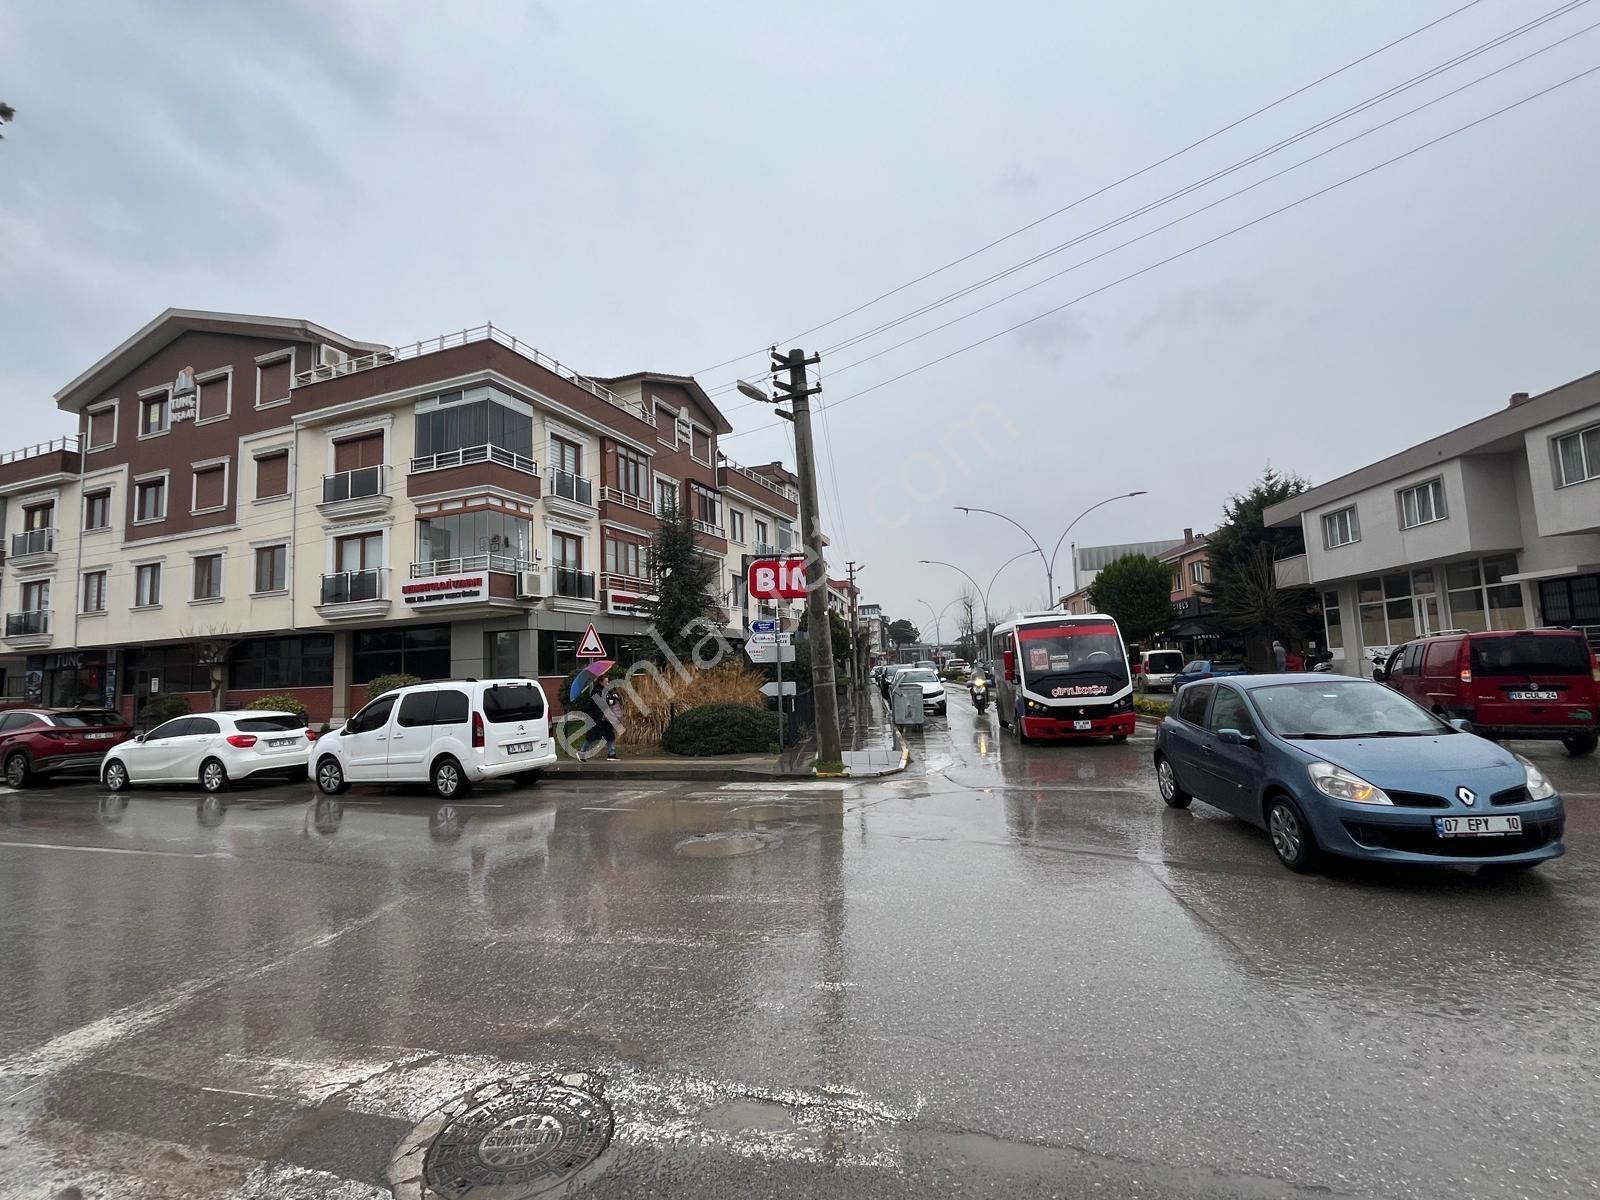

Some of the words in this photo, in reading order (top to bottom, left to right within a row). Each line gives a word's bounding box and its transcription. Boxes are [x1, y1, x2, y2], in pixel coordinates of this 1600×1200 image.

[56, 654, 84, 669] TUNÇ
[1524, 691, 1543, 699] CUL
[1445, 819, 1458, 832] 07
[1468, 818, 1489, 831] EPY
[1506, 817, 1519, 829] 10
